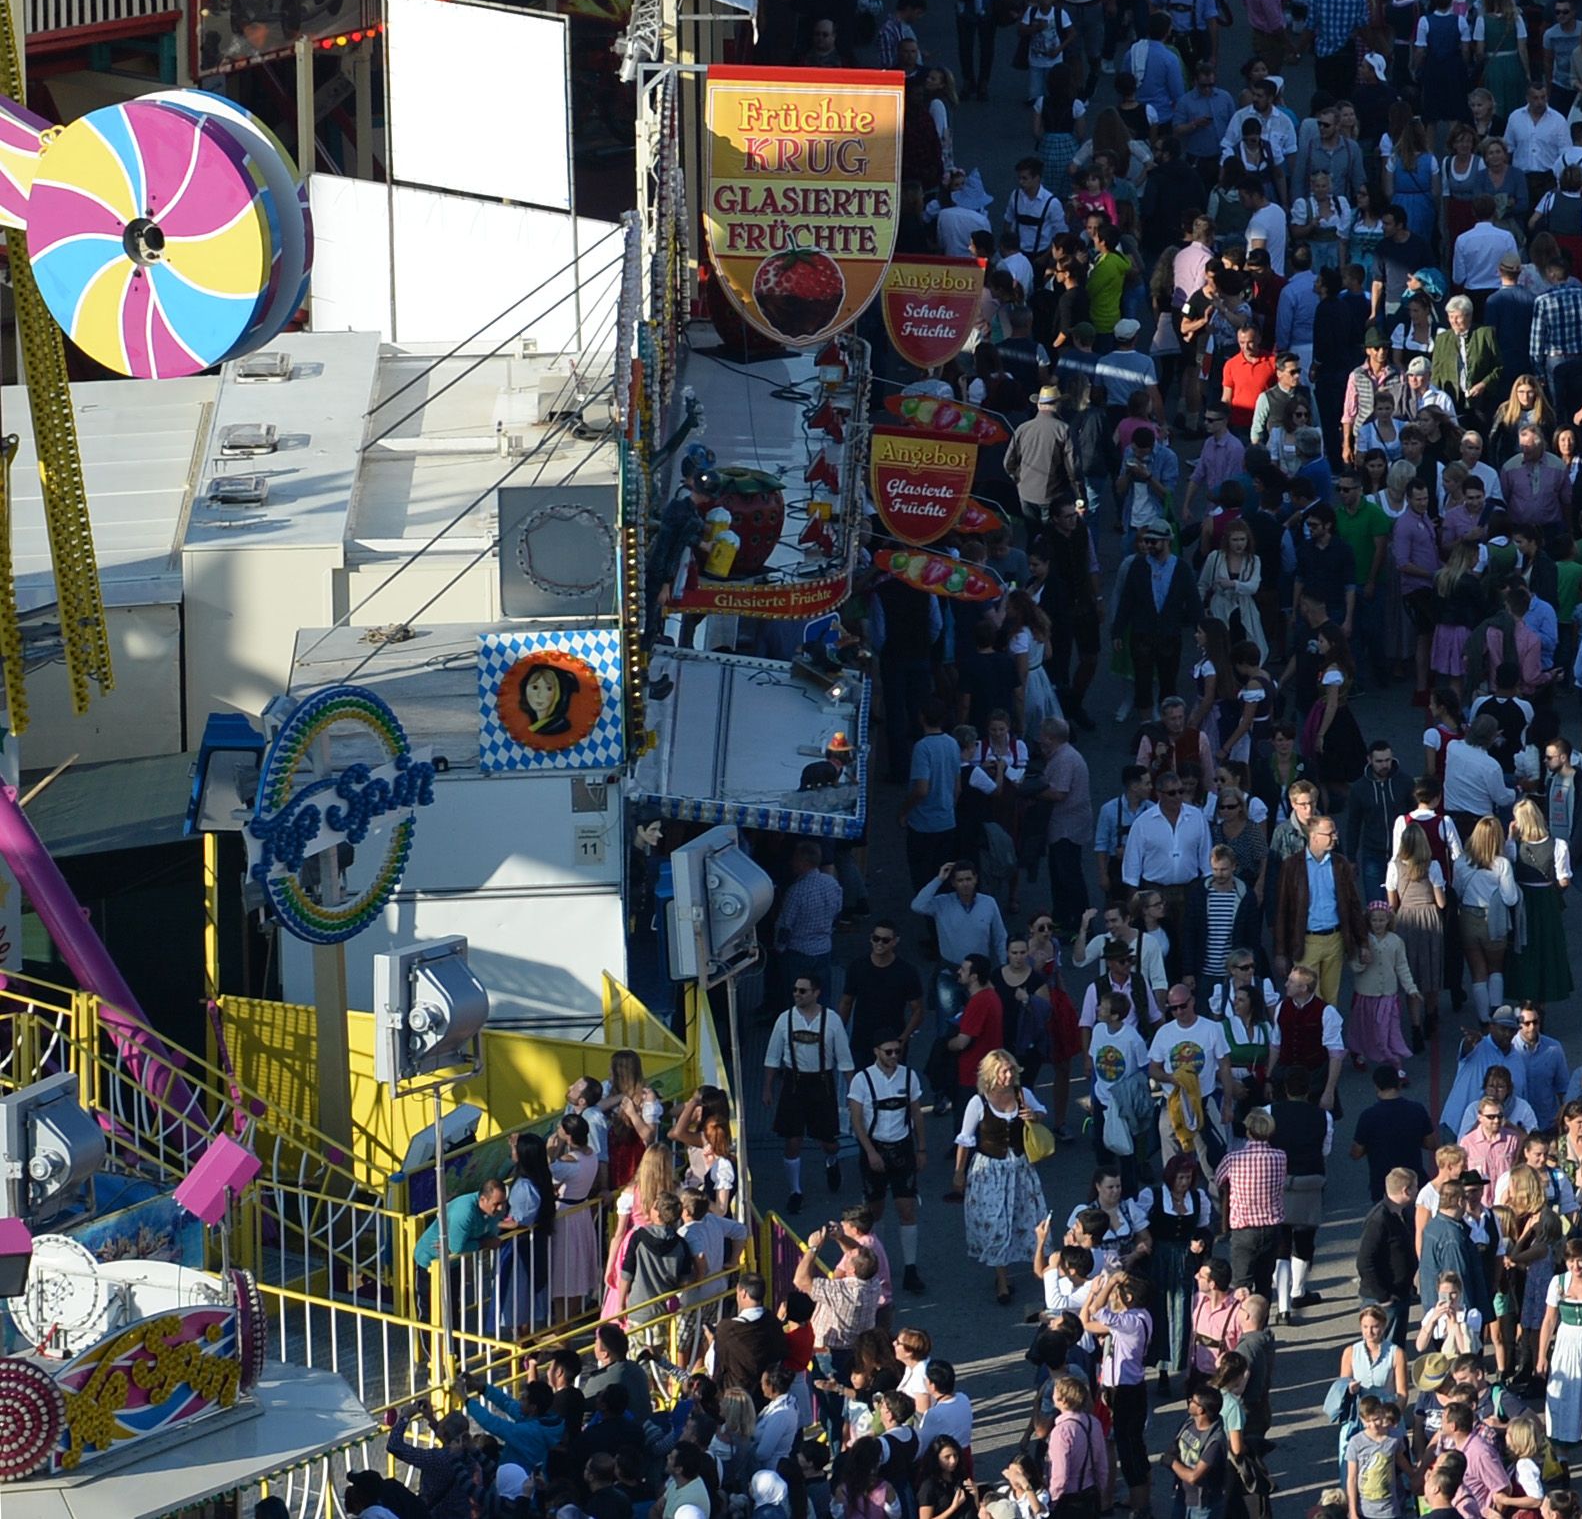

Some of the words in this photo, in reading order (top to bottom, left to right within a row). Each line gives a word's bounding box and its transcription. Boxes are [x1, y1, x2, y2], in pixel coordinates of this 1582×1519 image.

[739, 98, 875, 134] Früchte
[743, 137, 870, 174] KRUG
[713, 185, 892, 220] GLASIERTE
[727, 222, 879, 256] FRÜCHTE
[889, 268, 976, 295] Angebot
[903, 304, 960, 321] Schoko-
[902, 324, 957, 339] Früchte
[879, 438, 970, 469] Angebot
[886, 478, 954, 498] Glasierte
[889, 499, 948, 517] Früchte
[714, 593, 787, 608] Glasierte
[791, 588, 833, 607] Früchte
[582, 842, 598, 855] 11
